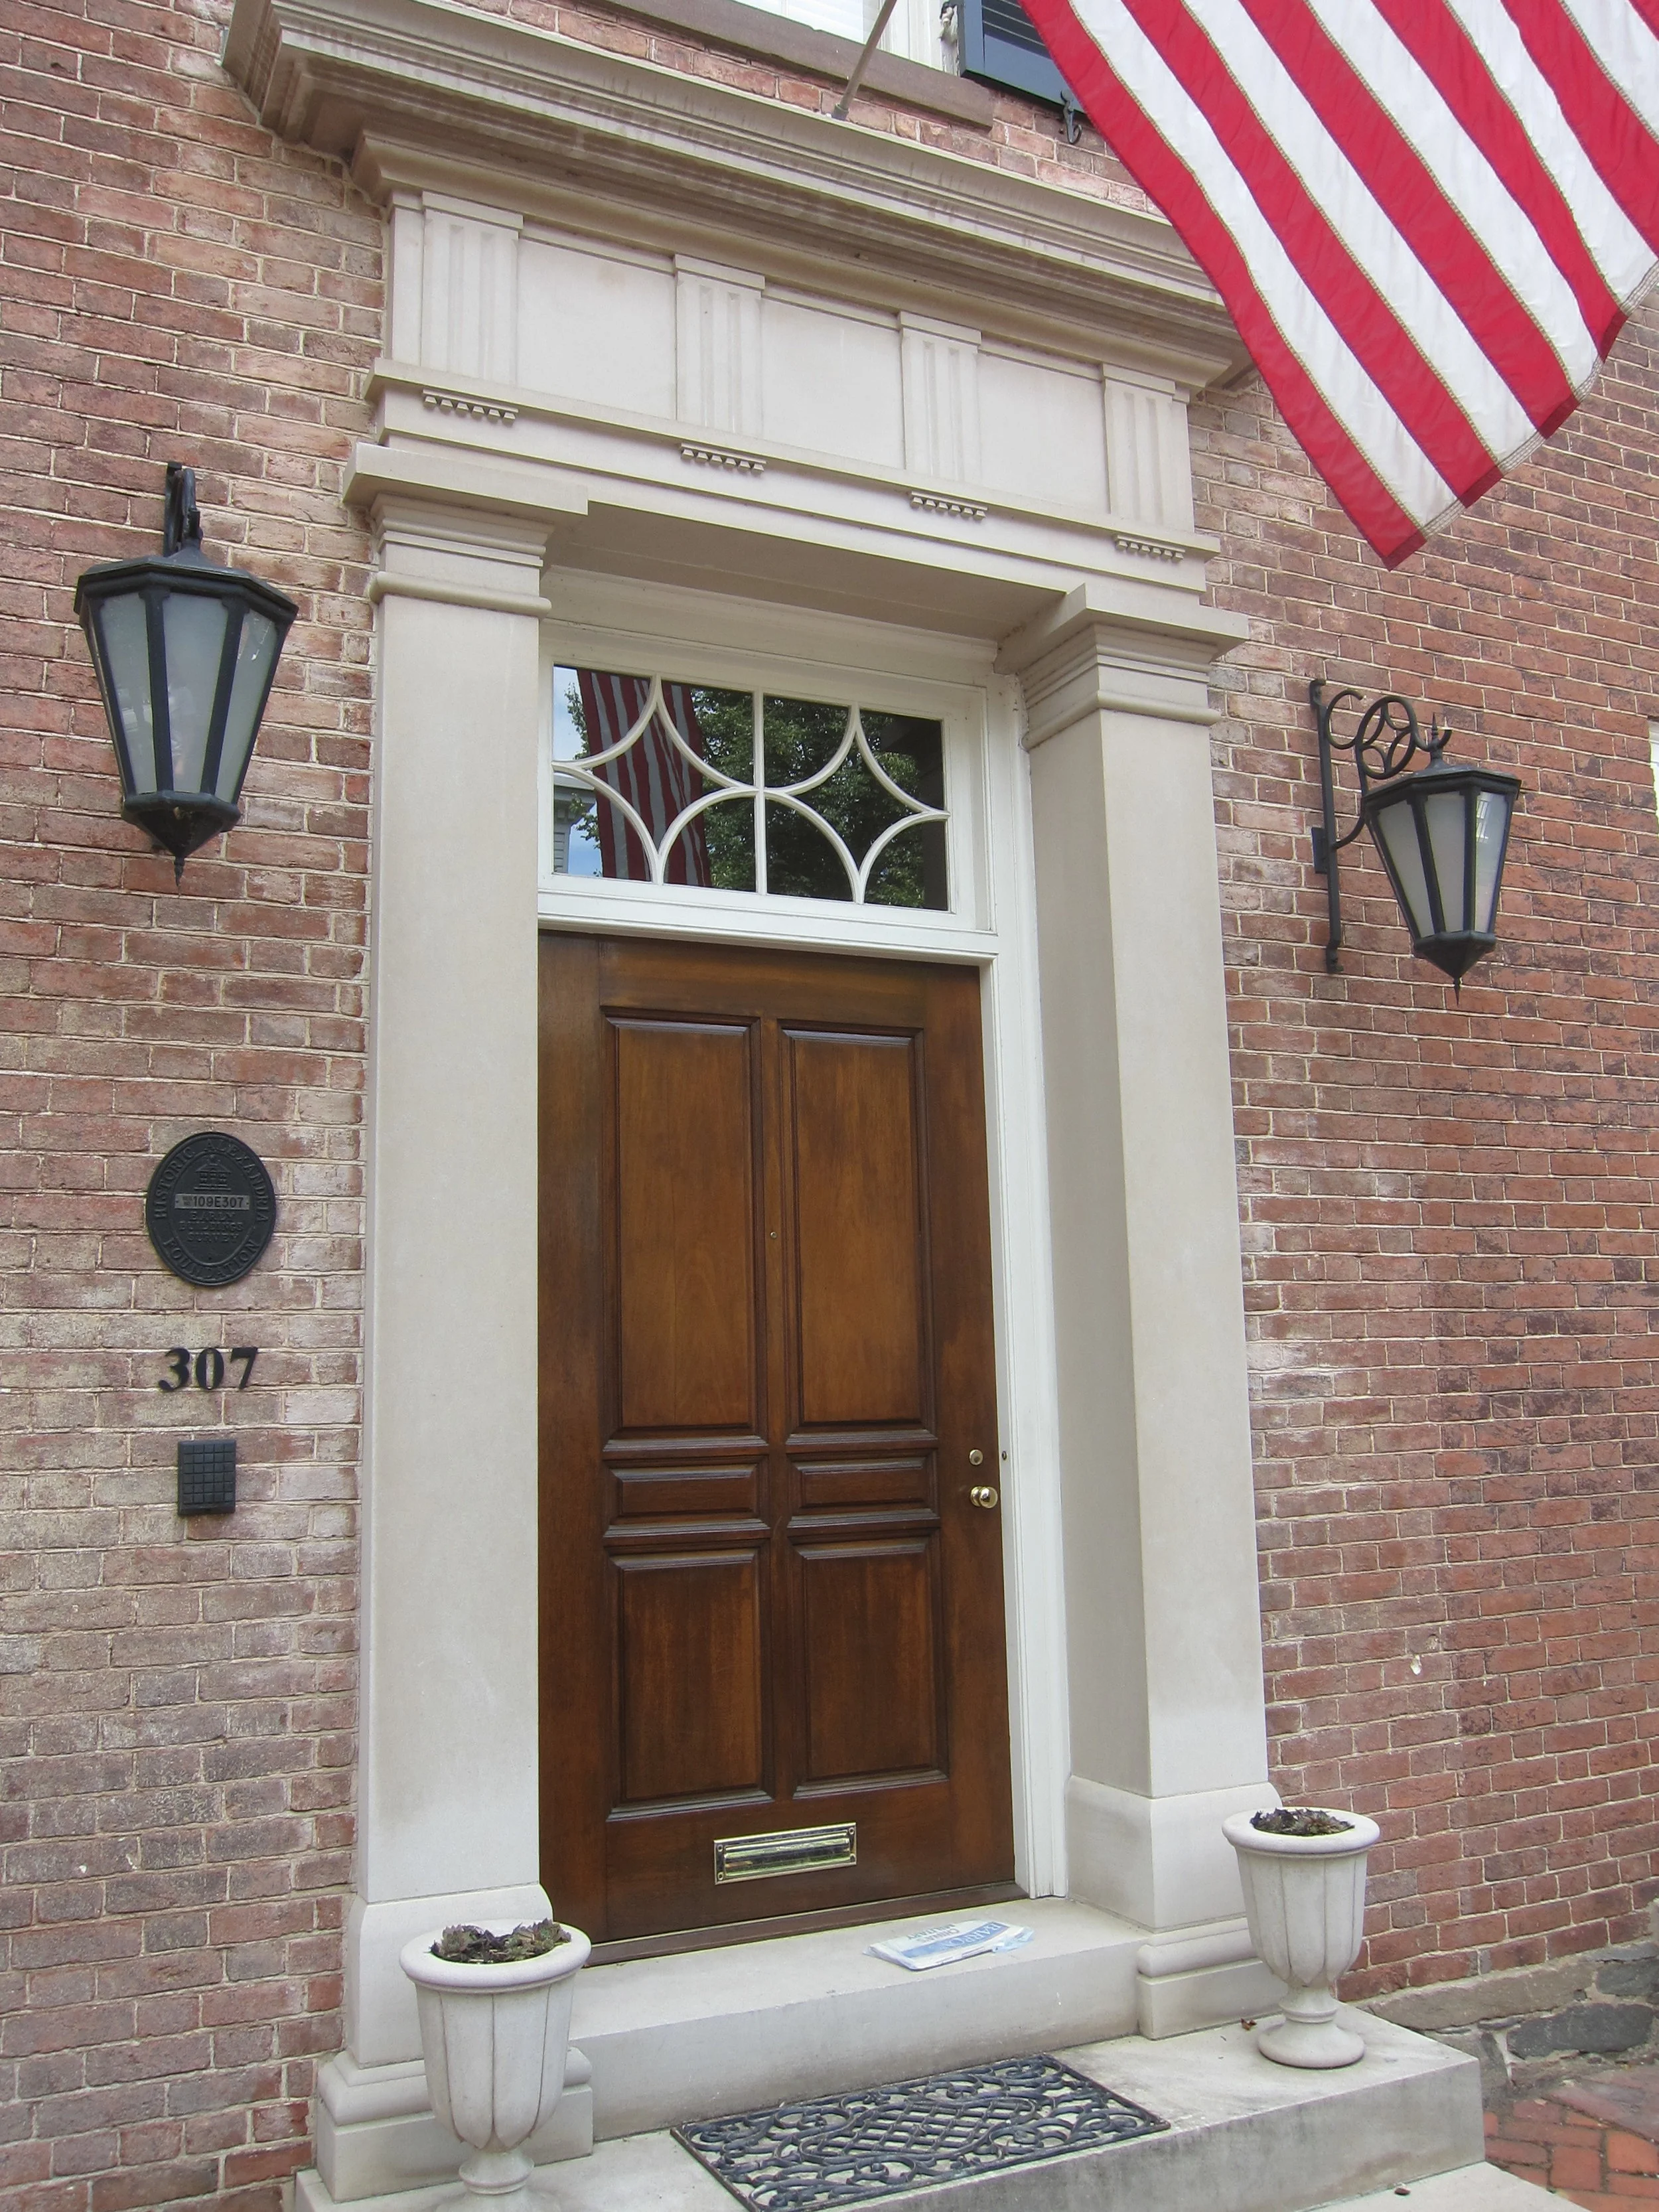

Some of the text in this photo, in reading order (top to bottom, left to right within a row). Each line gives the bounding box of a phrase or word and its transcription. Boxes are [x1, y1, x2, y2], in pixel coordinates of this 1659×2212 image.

[154, 1138, 269, 1222] HISTORIC ALEXANDRIA
[190, 1211, 236, 1220] EARLY
[194, 1196, 244, 1208] 109E307
[187, 1232, 239, 1242] SURVEY
[163, 1238, 259, 1280] FOUNDATION
[158, 1347, 258, 1390] 307
